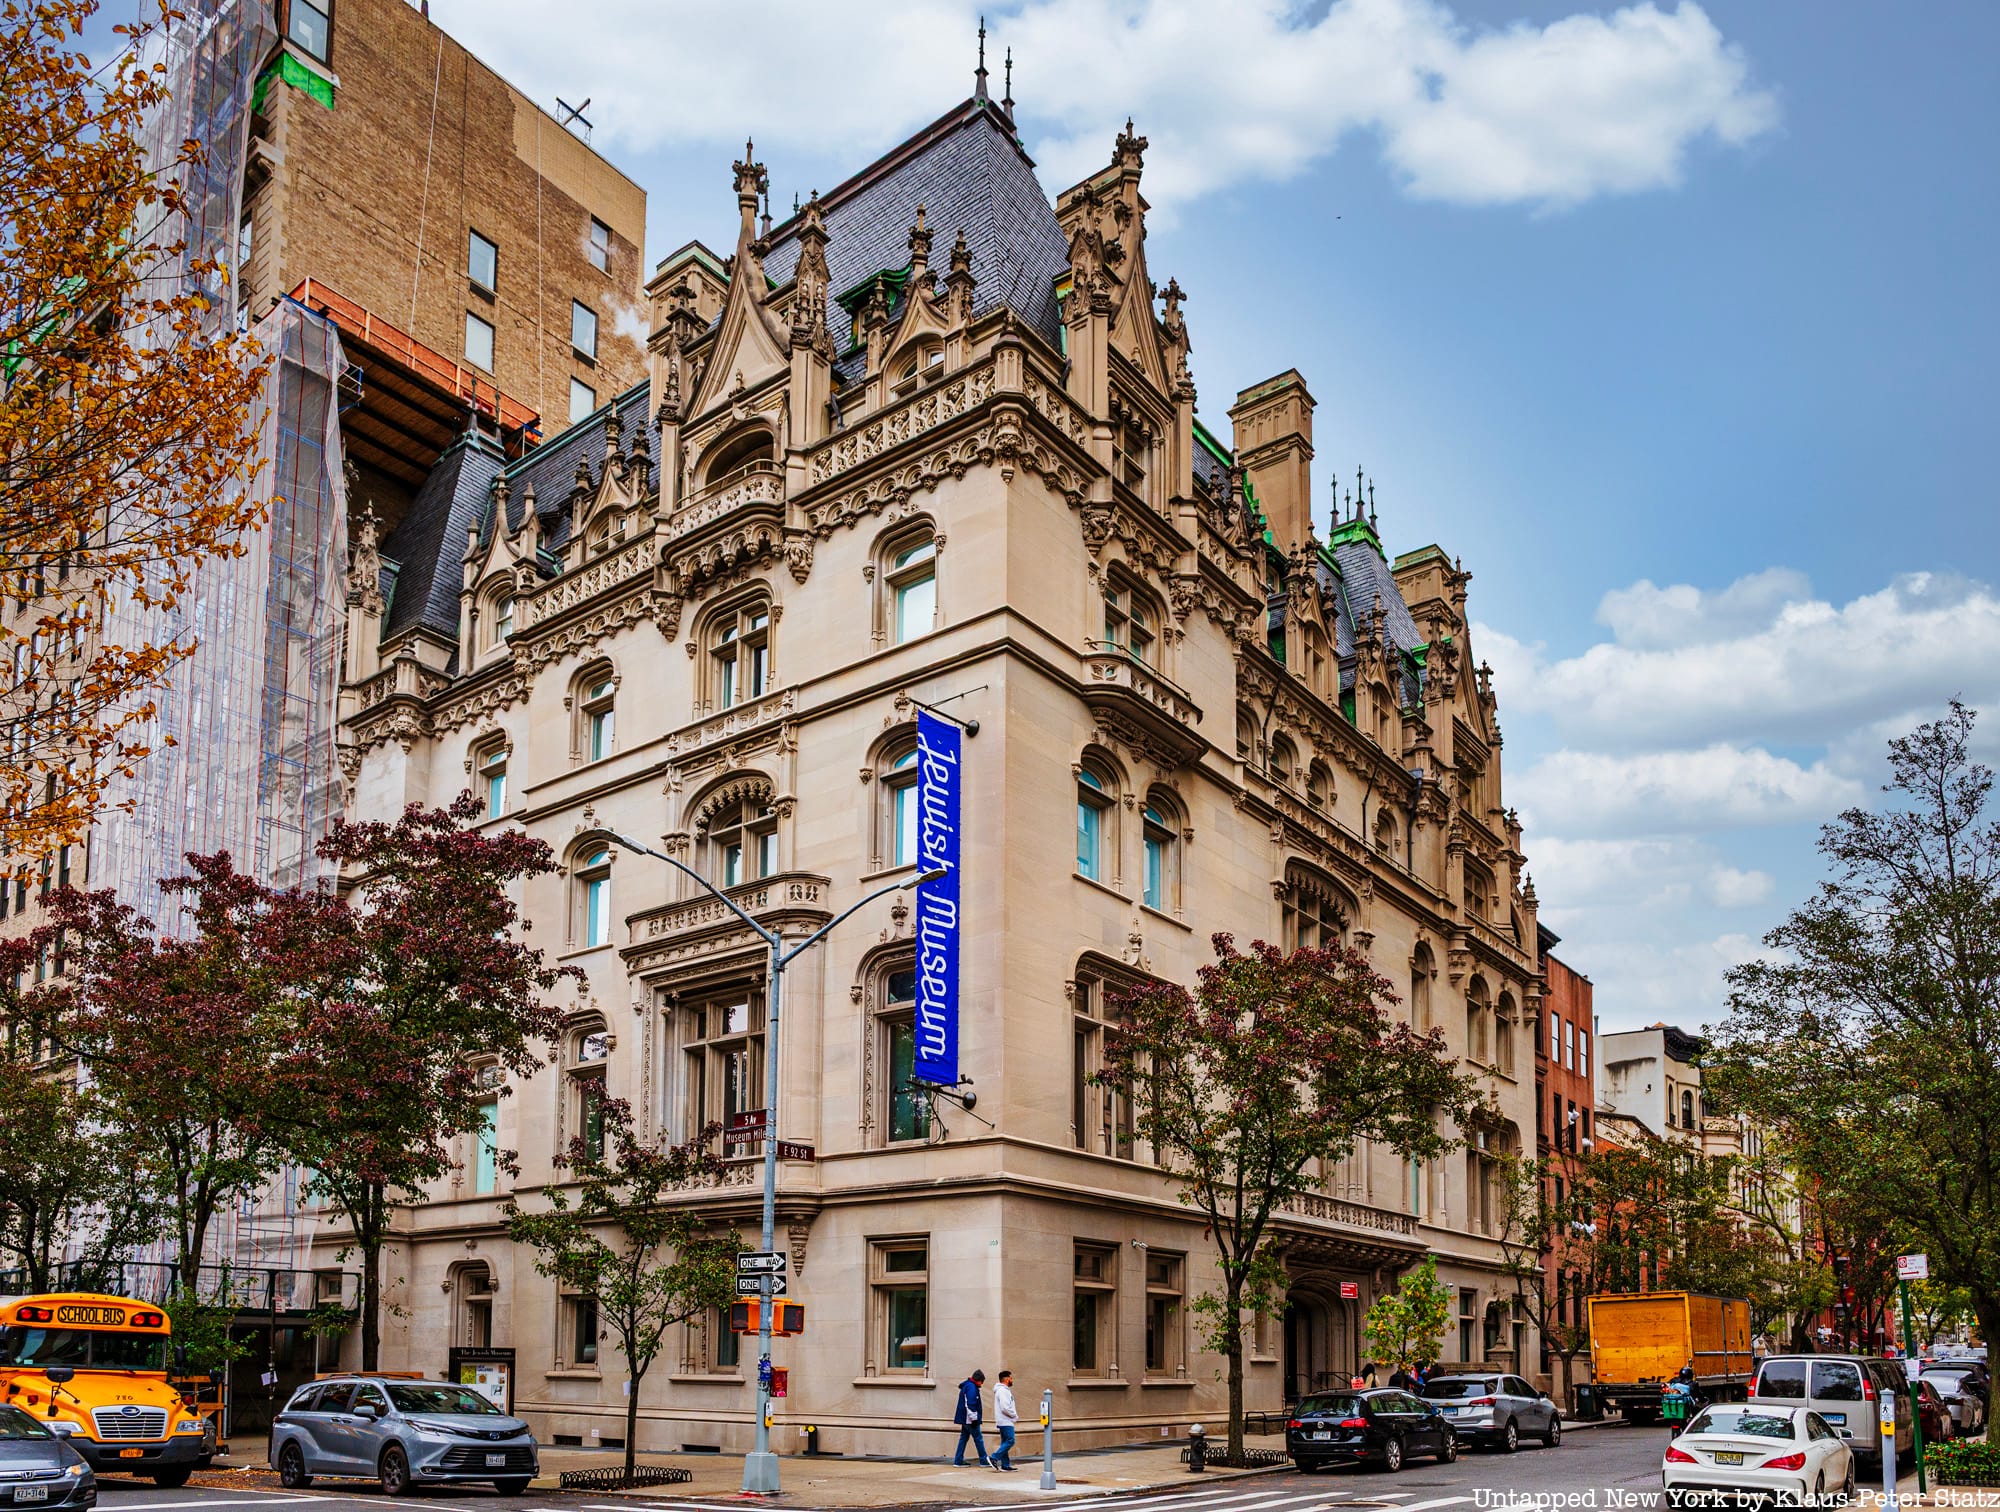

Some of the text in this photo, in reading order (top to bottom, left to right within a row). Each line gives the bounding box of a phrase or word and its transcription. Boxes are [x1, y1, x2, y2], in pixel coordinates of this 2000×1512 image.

[918, 731, 957, 1060] Jewish Museum
[744, 1115, 757, 1126] 5 Av
[725, 1128, 766, 1144] Museum Mile
[784, 1146, 807, 1160] E 92 St
[741, 1257, 780, 1268] ONE WAY
[740, 1280, 781, 1289] ONE AY
[59, 1306, 124, 1325] SCHOOL BUS
